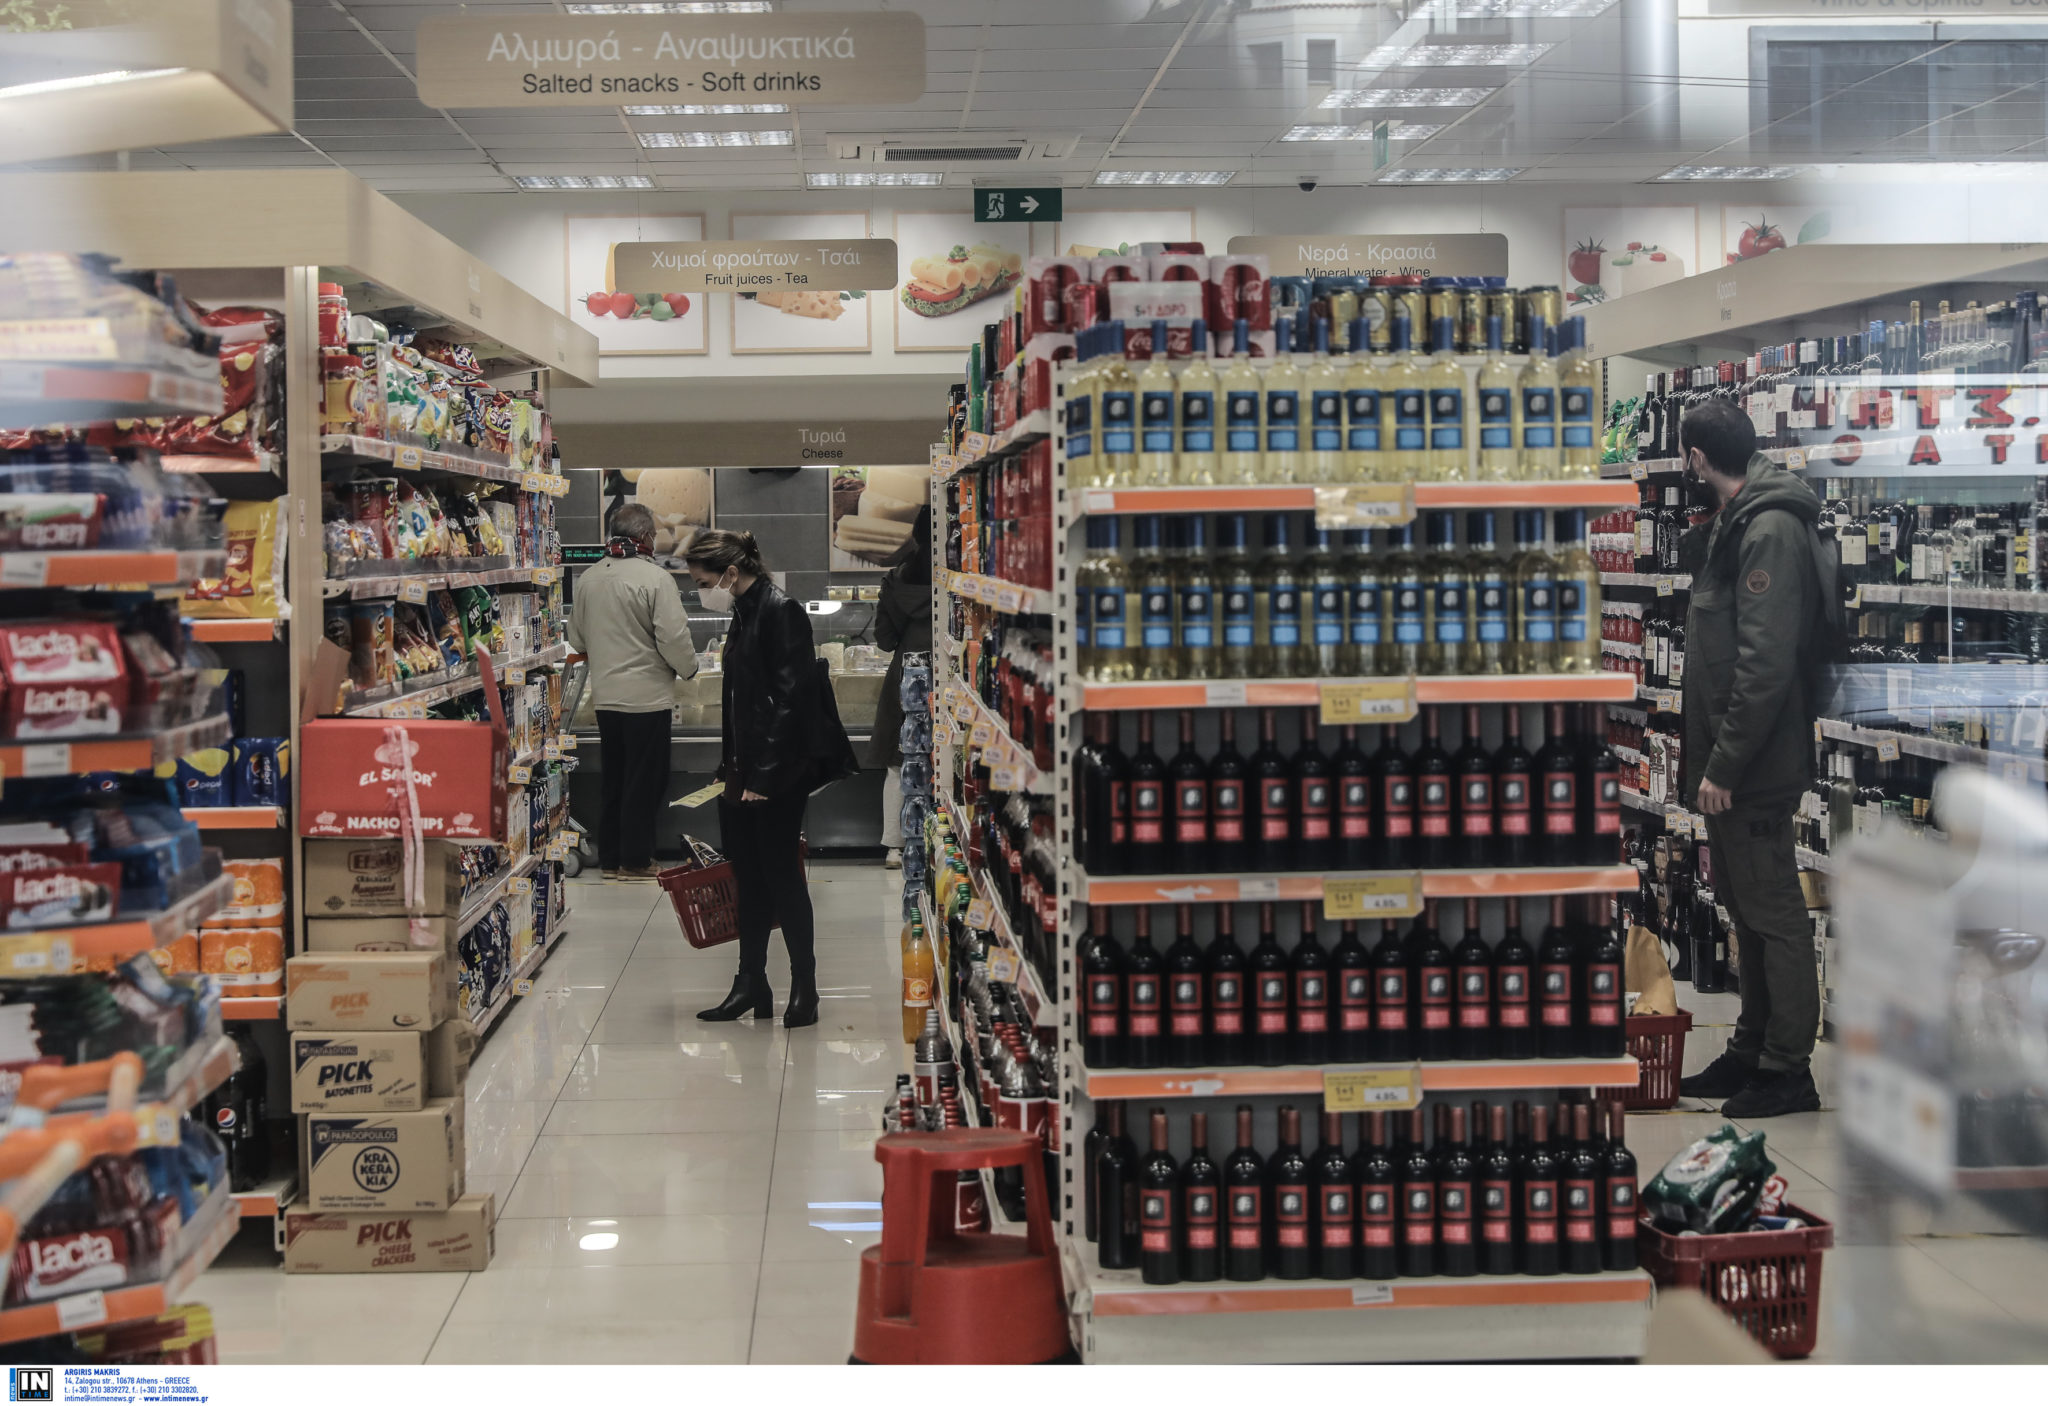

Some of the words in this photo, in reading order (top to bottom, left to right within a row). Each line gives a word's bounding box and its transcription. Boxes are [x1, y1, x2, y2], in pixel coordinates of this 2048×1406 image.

[486, 29, 621, 68] Αλμυρά
[654, 28, 856, 67] Αναψυκτικά
[522, 73, 593, 94] Salted
[601, 72, 679, 93] snacks
[701, 71, 746, 92] Soft
[753, 71, 822, 92] drinks
[651, 250, 708, 271] Χυμοί
[712, 247, 800, 271] φρούτων
[817, 248, 862, 267] Τσάι
[1298, 244, 1349, 265] Νερά
[1368, 242, 1437, 264] Κρασιά
[705, 273, 733, 285] Fruit
[736, 273, 773, 288] juices
[785, 272, 808, 285] Tea
[1305, 266, 1350, 278] Mineral
[1353, 268, 1388, 278] water
[1399, 266, 1431, 277] Wine
[798, 427, 847, 446] Τυριά
[802, 448, 844, 459] Cheese
[359, 772, 379, 787] EL
[381, 767, 432, 787] SAOR
[348, 817, 401, 829] NACHO
[0, 849, 45, 873] acta
[330, 991, 370, 1011] PICK
[318, 1060, 374, 1086] PICK
[324, 1084, 373, 1098] BATONETTES
[331, 1129, 397, 1142] PAPADOPOULOS
[364, 1153, 389, 1164] KRA
[359, 1163, 393, 1175] KERA
[366, 1174, 388, 1186] KIA
[357, 1219, 412, 1245] PICK
[379, 1243, 412, 1256] CHEESE
[372, 1253, 416, 1268] CRACKERS
